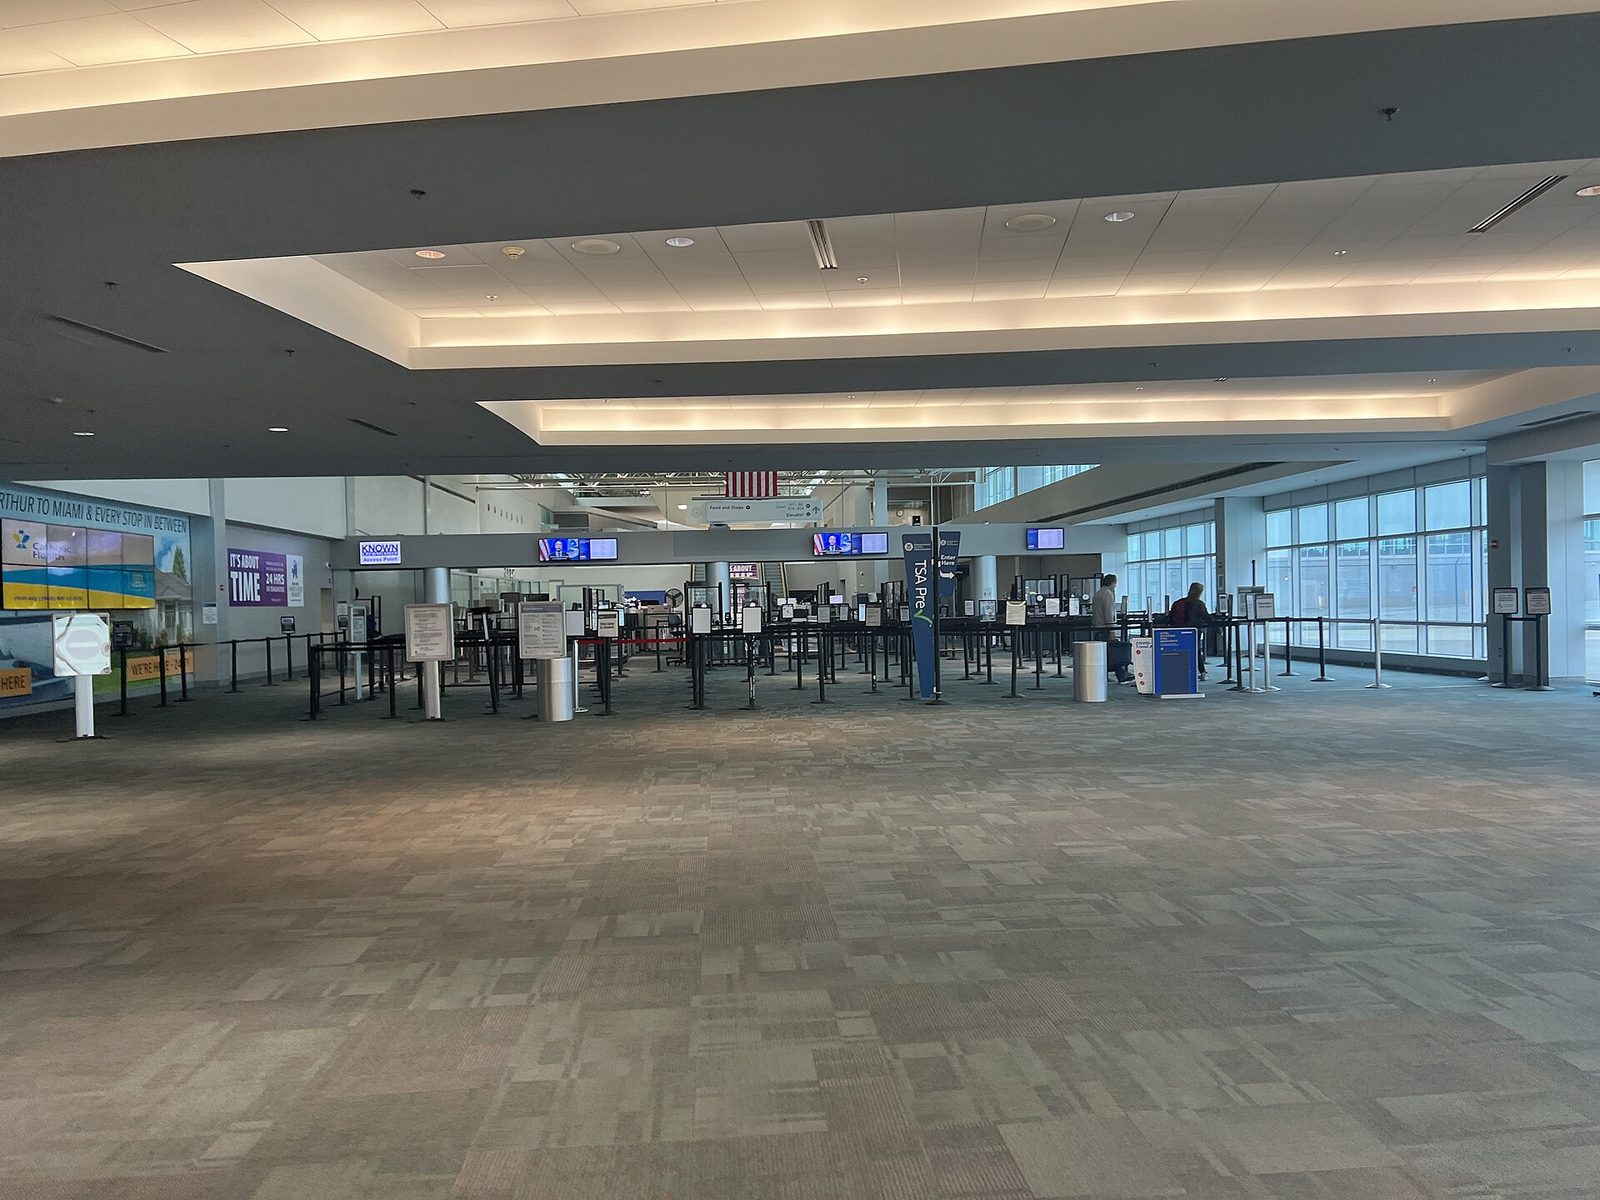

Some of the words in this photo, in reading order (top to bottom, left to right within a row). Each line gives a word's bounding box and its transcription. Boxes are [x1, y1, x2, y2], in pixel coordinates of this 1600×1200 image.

[37, 498, 50, 515] TO
[52, 500, 84, 519] MIAMI
[86, 505, 93, 520] &
[95, 506, 122, 524] EVERY
[122, 510, 144, 528] STOP
[144, 514, 153, 528] IN
[154, 516, 188, 533] BETWEEN
[362, 544, 398, 553] KNOWN
[230, 554, 241, 568] IT'S
[241, 554, 259, 569] ABOUT
[266, 572, 273, 584] 24
[273, 573, 285, 585] HRS
[914, 560, 928, 584] TSA
[230, 571, 260, 602] TIME
[915, 587, 928, 609] Pre
[132, 661, 152, 676] WE'RE
[154, 660, 170, 673] HE
[1, 674, 26, 691] HERE
